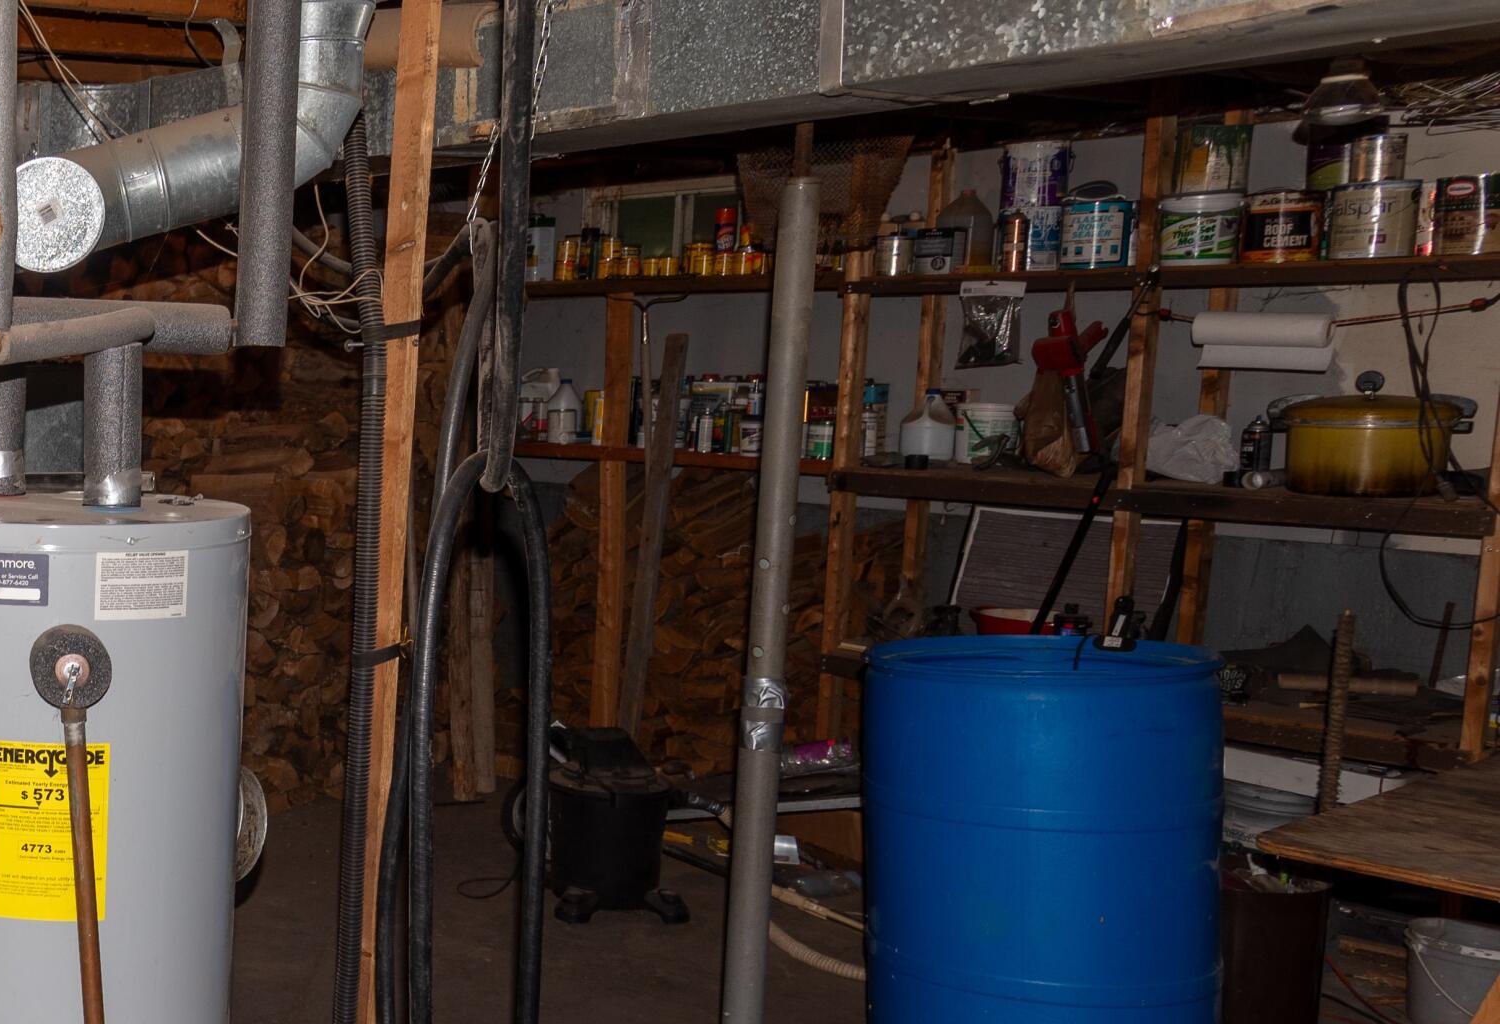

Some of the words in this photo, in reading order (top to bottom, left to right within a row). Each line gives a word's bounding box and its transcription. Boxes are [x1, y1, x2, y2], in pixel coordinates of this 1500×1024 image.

[1334, 200, 1397, 219] alspar
[1071, 230, 1112, 239] SEAER
[1264, 223, 1295, 236] ROOF
[1263, 235, 1309, 248] CEMENT
[21, 790, 28, 800] $
[33, 788, 65, 801] 573
[21, 843, 52, 853] 4773
